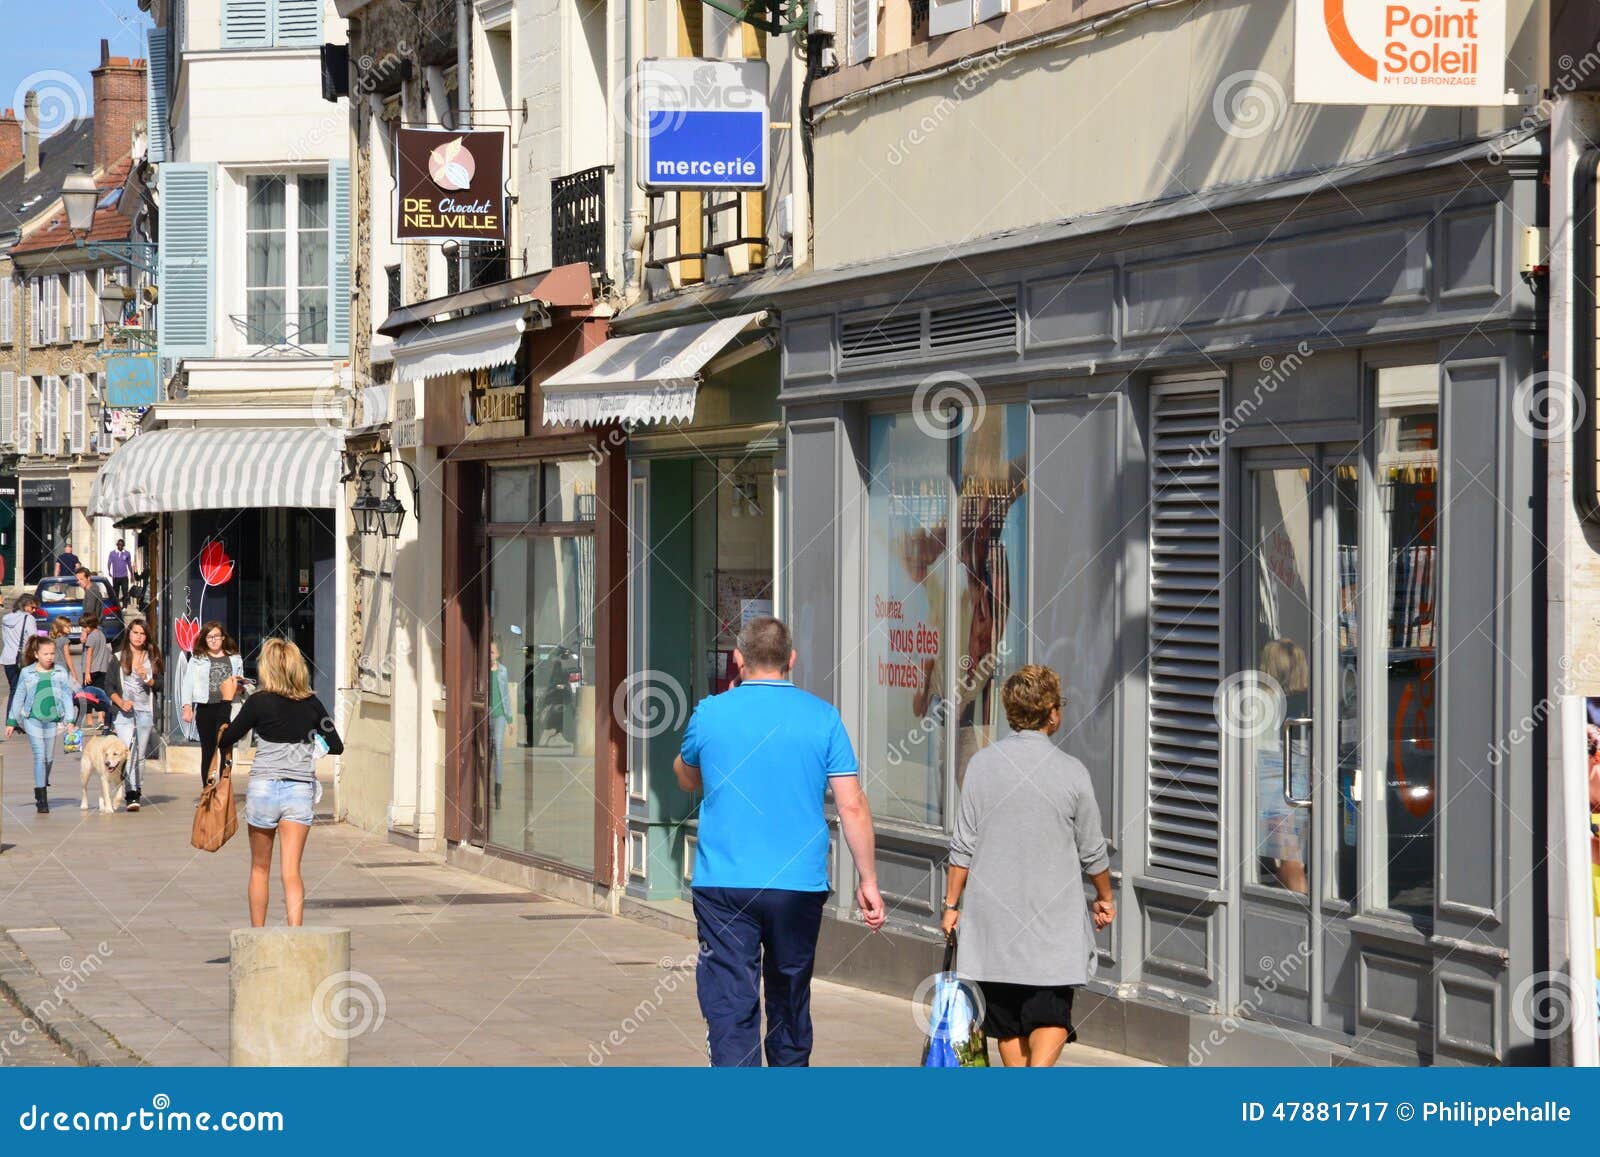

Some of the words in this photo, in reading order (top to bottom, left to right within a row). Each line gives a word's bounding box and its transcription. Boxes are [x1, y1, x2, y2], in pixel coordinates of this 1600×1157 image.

[1385, 5, 1478, 38] Point
[1384, 41, 1477, 74] Soleil
[1404, 77, 1418, 85] DU
[1421, 77, 1477, 86] BRONZAGE
[658, 85, 753, 108] DMC
[656, 157, 756, 175] mercerie
[404, 198, 432, 213] DE
[438, 197, 491, 214] Chocolat
[404, 214, 498, 229] NEUVILLE
[889, 628, 914, 654] vous
[916, 621, 939, 655] êtes
[878, 656, 918, 689] bronzés
